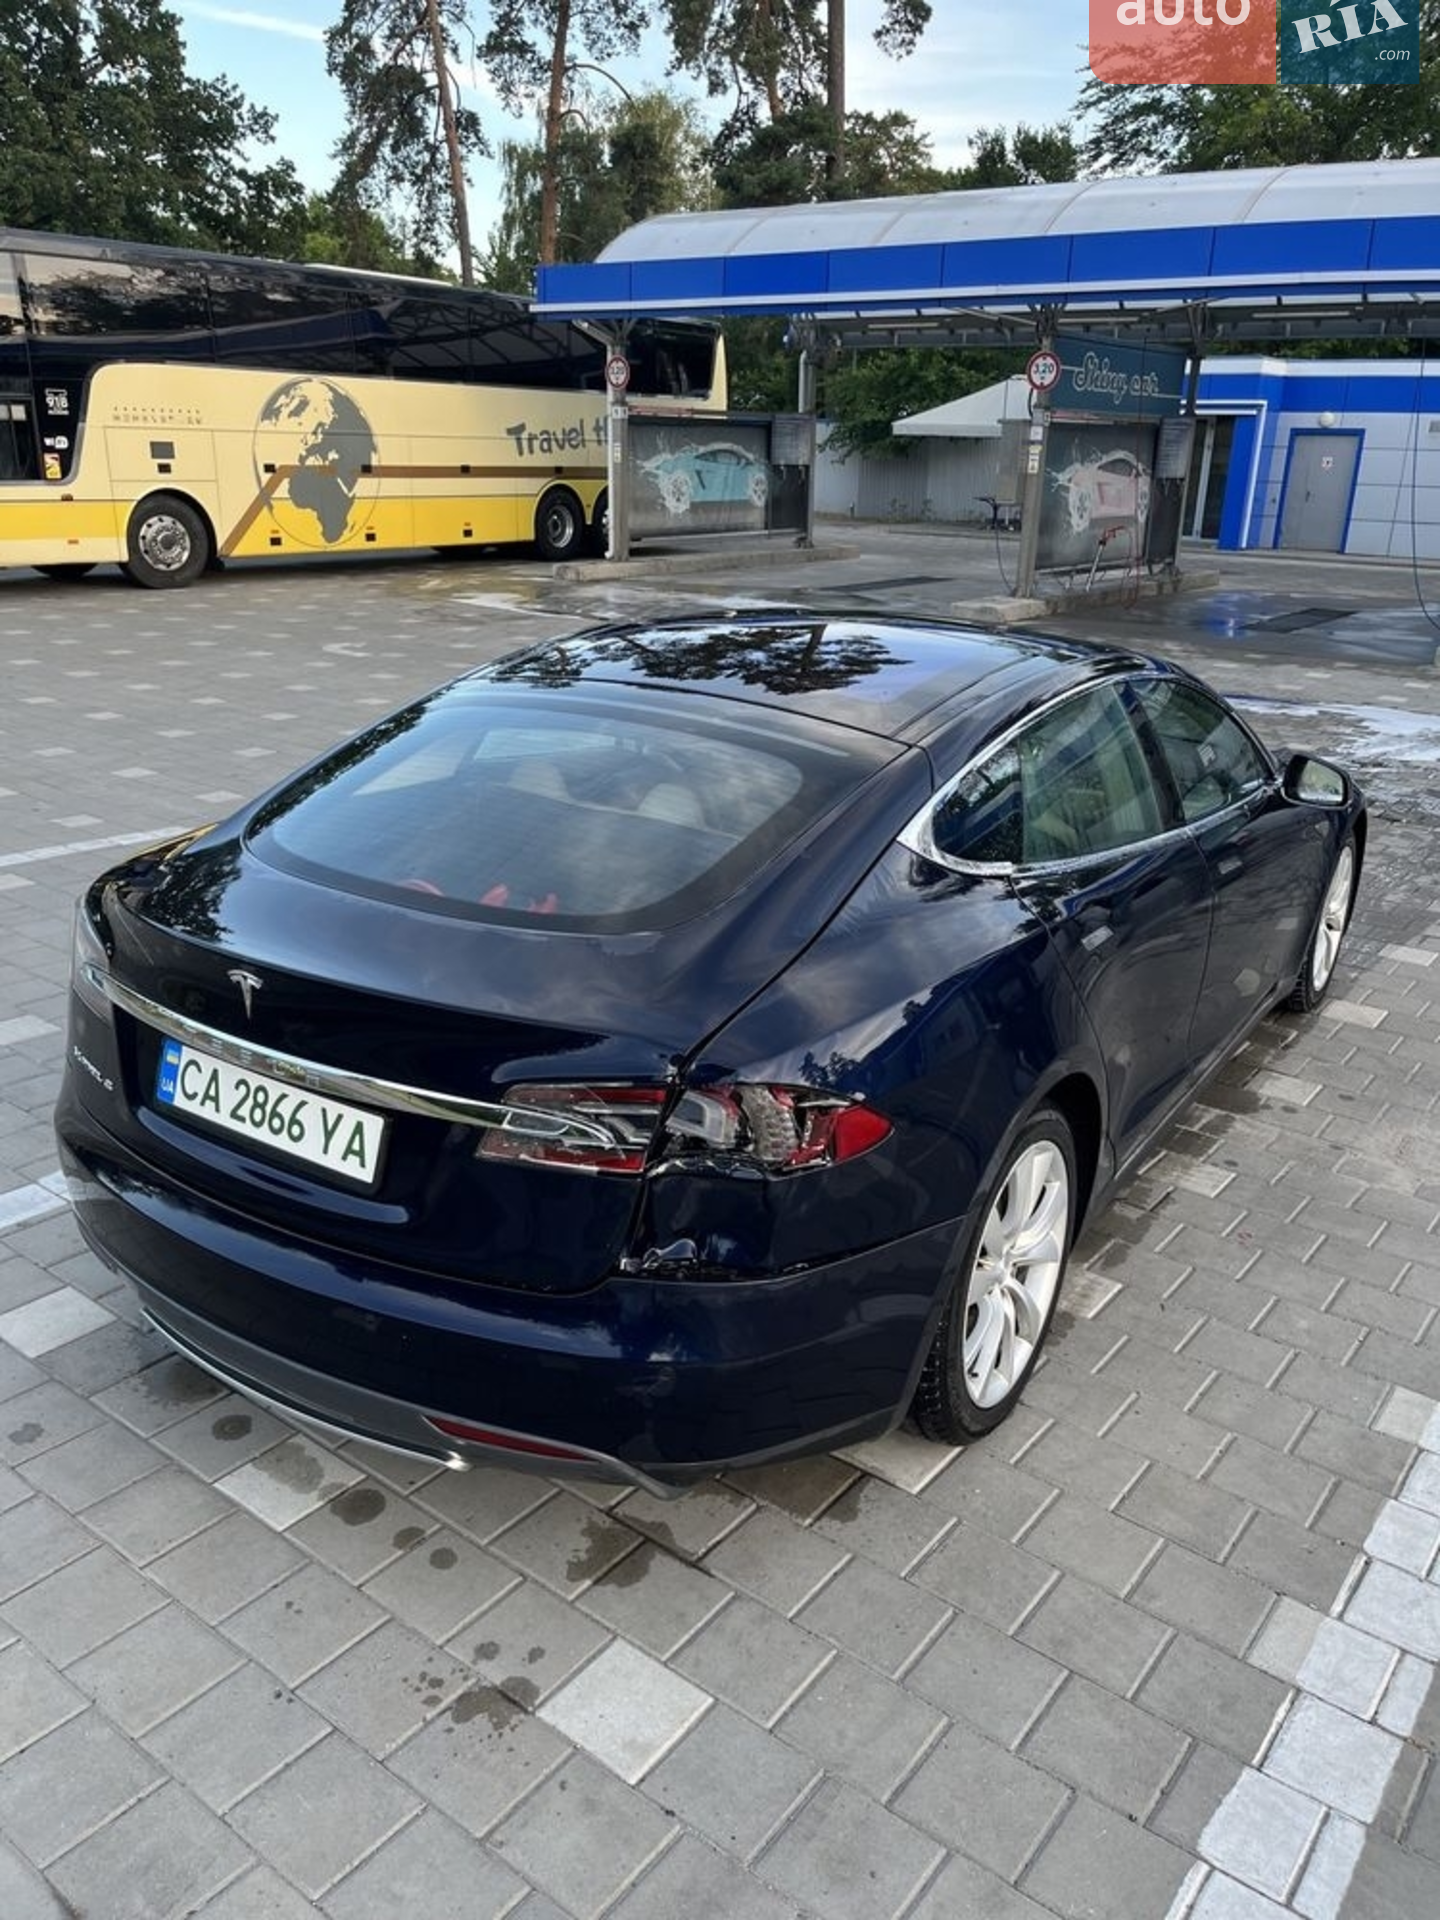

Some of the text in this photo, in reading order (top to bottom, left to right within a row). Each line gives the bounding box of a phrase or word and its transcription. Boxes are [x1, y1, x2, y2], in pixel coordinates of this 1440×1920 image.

[506, 418, 586, 457] Travel
[160, 1076, 175, 1095] UA
[180, 1058, 221, 1114] CA
[229, 1078, 309, 1144] 2866
[321, 1107, 367, 1169] YA
